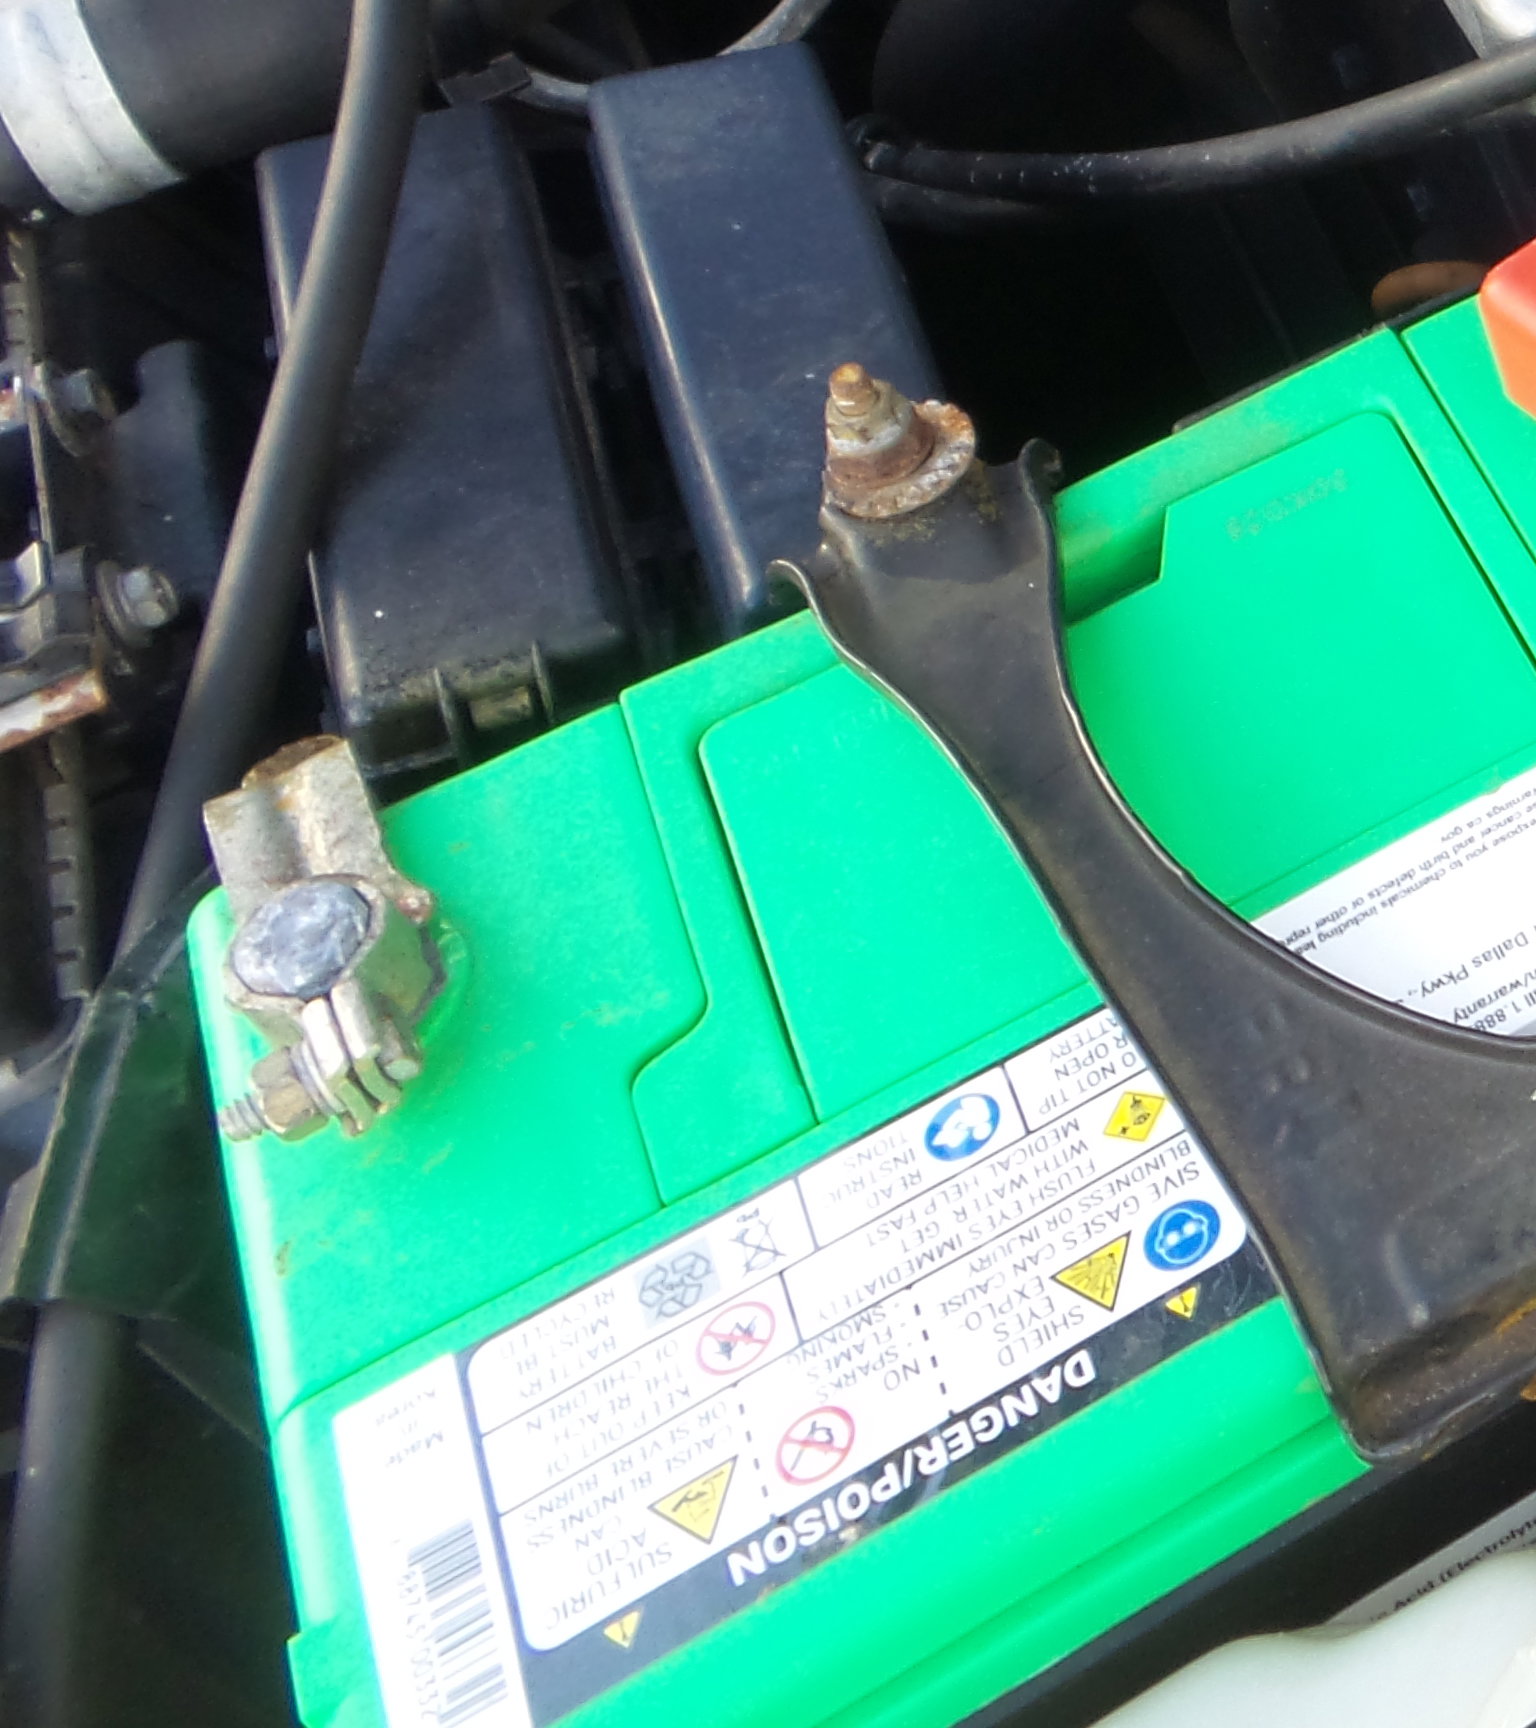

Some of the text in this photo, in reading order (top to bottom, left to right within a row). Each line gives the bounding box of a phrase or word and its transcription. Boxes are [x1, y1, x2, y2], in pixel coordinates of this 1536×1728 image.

[1367, 869, 1416, 899] defects
[1380, 868, 1446, 908] chemicals
[1317, 906, 1377, 943] including
[1472, 932, 1528, 968] Dallas
[1050, 1012, 1121, 1063] ATTERY
[1054, 1042, 1109, 1080] OPEN
[1077, 1061, 1117, 1093] NOT
[1039, 1088, 1070, 1115] TIP
[987, 1118, 1080, 1177] MEDICAL
[1033, 1139, 1088, 1178] WITH
[867, 1168, 922, 1208] READ
[924, 1175, 979, 1215] HELP
[969, 1139, 1192, 1277] BLINDNESS OR INJURY
[820, 1158, 1096, 1320] FLUSH EYES IMMEDIATELY
[901, 1221, 940, 1254] GET
[939, 1161, 1200, 1318] SIVE GASES CAN CAUSE
[781, 1302, 886, 1365] SMOKING
[993, 1295, 1055, 1342] EYES
[997, 1305, 1084, 1367] SHIELD
[807, 1325, 893, 1380] FLAMES
[816, 1345, 899, 1405] SPARKS
[884, 1358, 920, 1391] NO
[711, 1350, 1095, 1586] DANGER/POISON
[587, 1528, 646, 1576] ACID
[546, 1542, 672, 1630] SULFURIC
